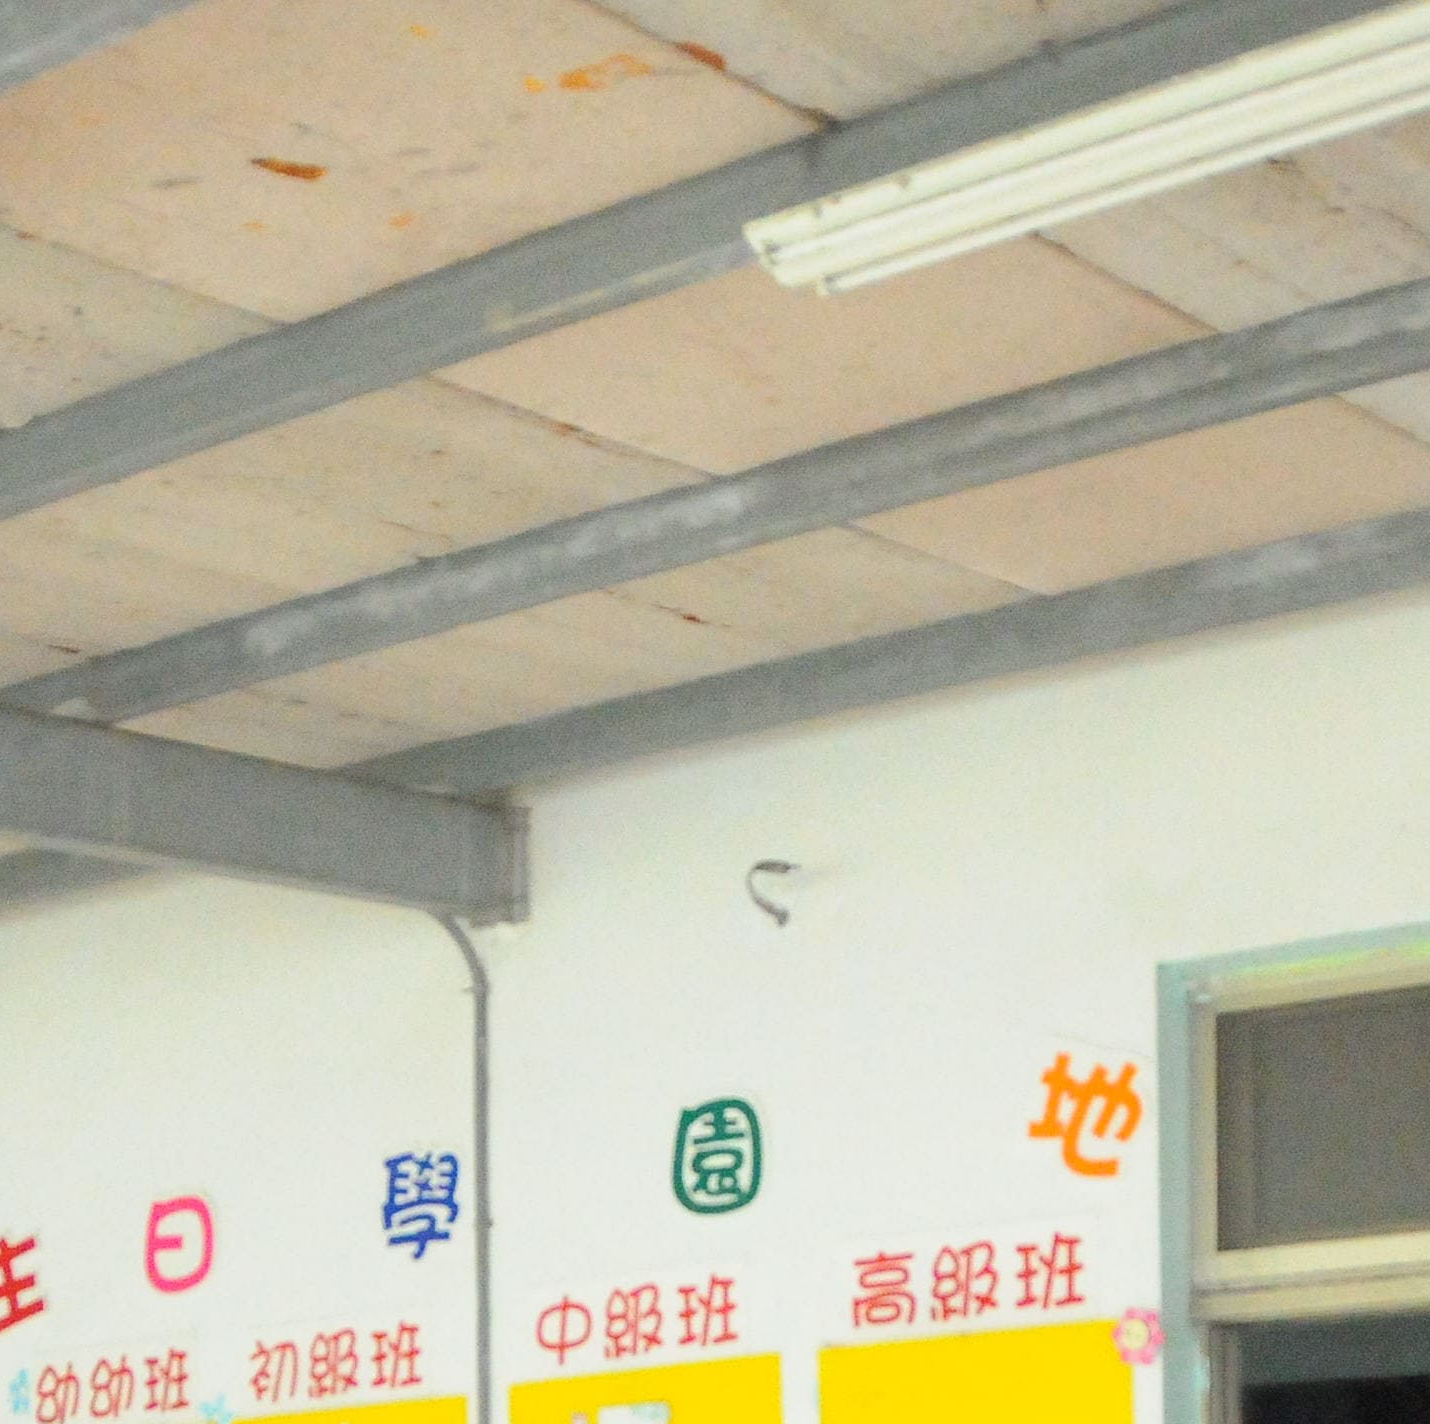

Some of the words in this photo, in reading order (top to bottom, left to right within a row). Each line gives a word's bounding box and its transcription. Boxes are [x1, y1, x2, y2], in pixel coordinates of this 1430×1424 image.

[144, 1194, 216, 1295] 日
[382, 1152, 461, 1260] 學
[672, 1097, 763, 1215] 園
[1027, 1052, 1145, 1180] 地
[535, 1273, 740, 1365] 中級班
[851, 1231, 1086, 1329] 高級班
[249, 1321, 424, 1401] 初級班
